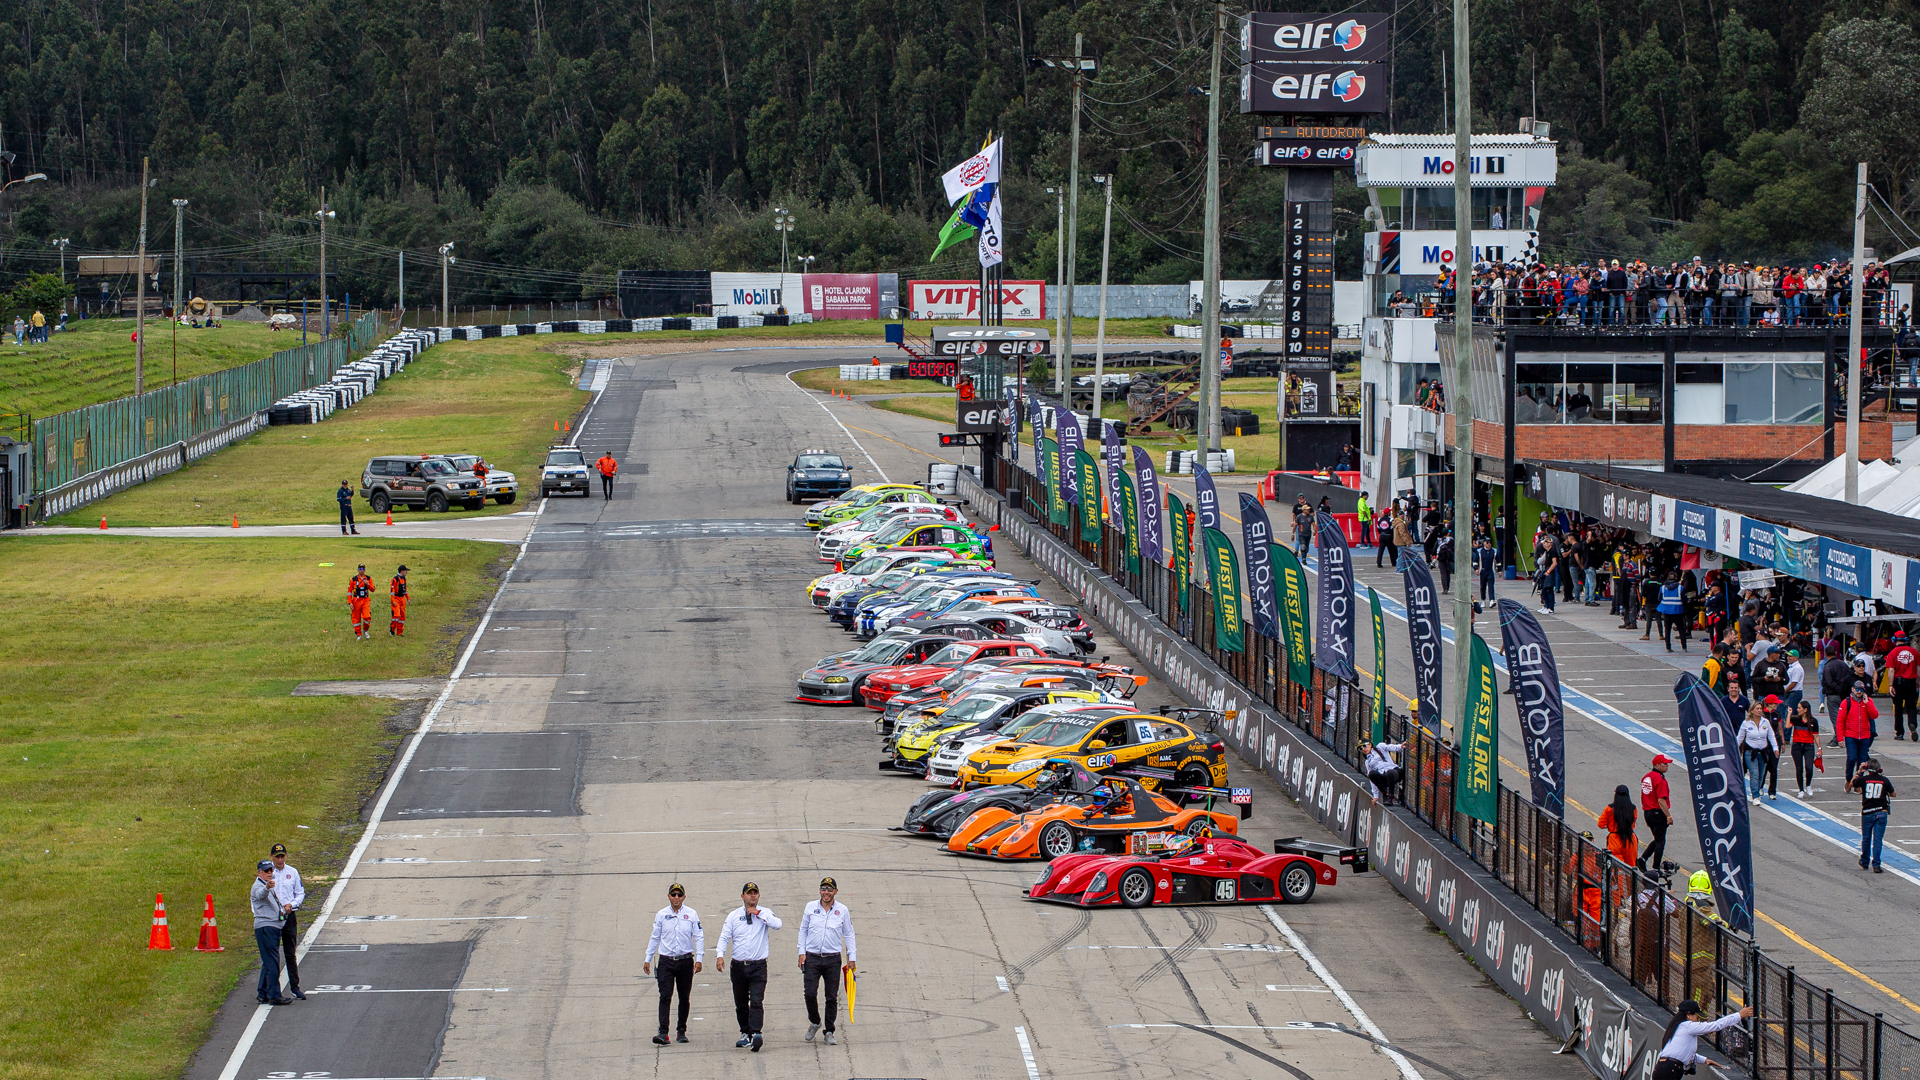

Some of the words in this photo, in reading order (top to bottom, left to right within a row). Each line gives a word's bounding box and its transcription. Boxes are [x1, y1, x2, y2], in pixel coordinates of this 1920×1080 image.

[1273, 23, 1332, 49] elf
[1272, 73, 1332, 99] elf
[1296, 127, 1366, 138] AUTODROM
[1274, 146, 1298, 158] elf
[1316, 147, 1340, 159] elf
[1424, 156, 1480, 174] Moil
[1491, 157, 1499, 173] 1
[1295, 204, 1302, 214] 1
[1293, 218, 1303, 229] 2
[1293, 234, 1302, 246] 3
[1293, 249, 1302, 260] 4
[1422, 246, 1479, 263] Moil
[1489, 246, 1497, 263] 1
[1292, 265, 1302, 276] 5
[824, 287, 844, 296] HOTEL
[844, 286, 871, 295] CLARION
[1292, 280, 1301, 291] 6
[733, 289, 768, 305] Mobil
[772, 289, 779, 304] 1
[825, 295, 849, 304] SABANA
[849, 295, 866, 303] PARK
[1292, 297, 1301, 308] 7
[1292, 312, 1301, 322] 8
[1291, 327, 1300, 338] 9
[942, 341, 971, 354] elf
[998, 341, 1027, 354] elf
[1288, 342, 1302, 353] 10
[964, 409, 997, 425] elf
[1083, 463, 1094, 496] WEST
[1086, 498, 1097, 528] LAKE
[1141, 467, 1158, 546] ARQUIB
[1682, 509, 1705, 527] AUTODROMO
[1681, 524, 1687, 537] DE
[1748, 542, 1755, 556] DE
[1827, 548, 1856, 569] AUTODROMO
[1217, 546, 1232, 592] WEST
[1252, 520, 1272, 620] ARQUIB
[1825, 564, 1833, 577] DE
[1322, 547, 1330, 612] INVERSIONES
[1284, 567, 1300, 617] WEST
[1328, 545, 1349, 660] ARQUIB
[1852, 600, 1877, 617] 85
[1222, 594, 1238, 632] LAKE
[1290, 619, 1306, 666] LAKE
[1414, 585, 1438, 714] ARQUIB
[1508, 644, 1529, 729] INVERSIONES
[1478, 664, 1493, 729] WEST
[1045, 717, 1096, 727] RENAULT
[1518, 641, 1557, 791] ARQUIB
[1139, 726, 1153, 739] 65
[1467, 701, 1480, 761] PERFORMANCE
[1145, 741, 1173, 753] RENAULT
[1087, 755, 1106, 767] elf
[1473, 732, 1490, 791] LAKE
[1525, 735, 1539, 778] GRUPO
[1686, 725, 1709, 828] INVERSIONES
[1232, 788, 1252, 796] LIQUI
[1232, 795, 1252, 803] MOLY
[1865, 783, 1883, 799] 90
[1697, 722, 1744, 901] ARQUIB
[1358, 808, 1367, 843] elf
[1375, 824, 1385, 860] elf
[1394, 840, 1406, 877] elf
[1704, 837, 1720, 889] GRUPO
[1415, 858, 1428, 895] elf
[1217, 881, 1234, 900] 45
[1438, 878, 1451, 917] elf
[1462, 898, 1474, 939] elf
[1485, 920, 1498, 961] elf
[1511, 943, 1526, 986] elf
[1541, 968, 1557, 1012] elf
[1642, 1049, 1661, 1080] el
[265, 1070, 333, 1079] 32
